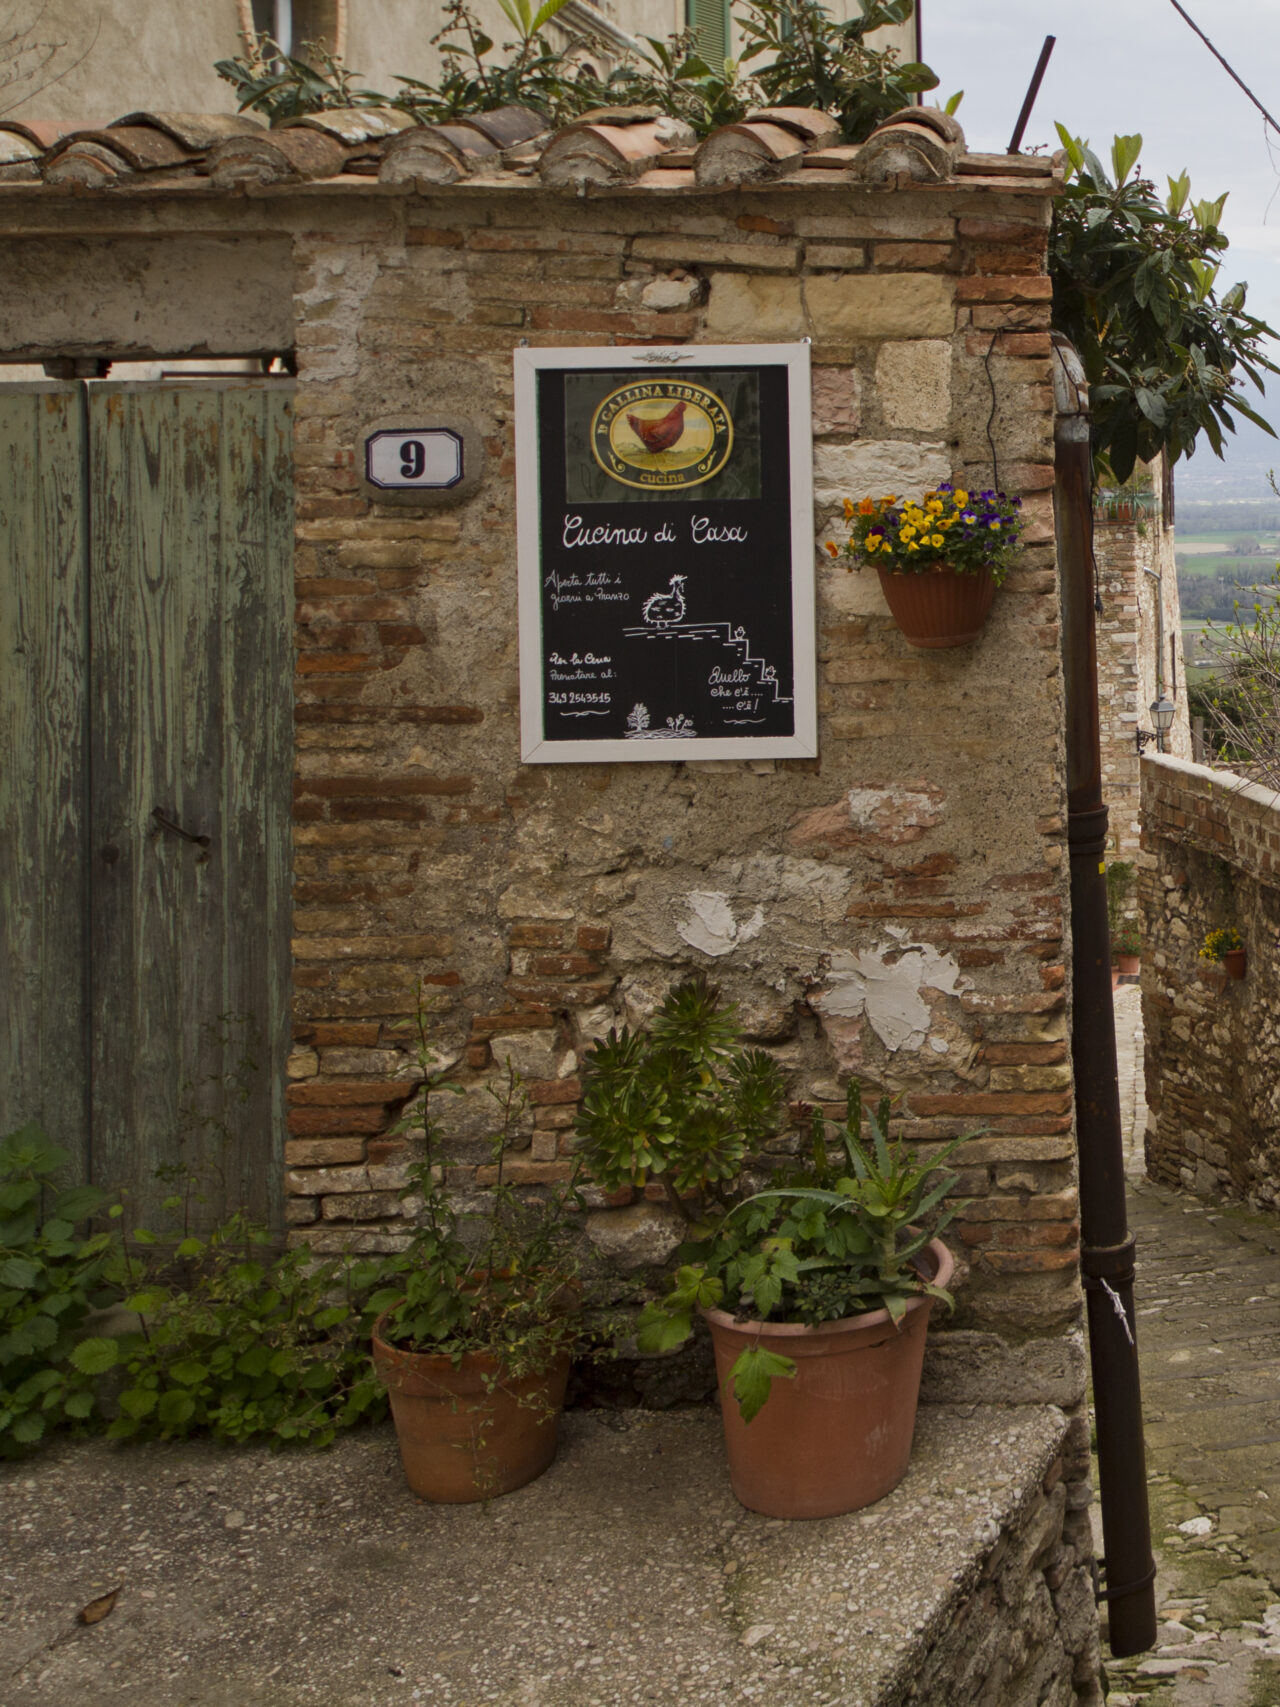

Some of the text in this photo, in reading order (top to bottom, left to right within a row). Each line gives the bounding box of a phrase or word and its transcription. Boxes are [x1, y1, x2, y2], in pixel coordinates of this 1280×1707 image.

[601, 385, 664, 421] GALLINA
[667, 385, 727, 434] LIBERATA
[400, 440, 425, 479] 9
[640, 472, 685, 484] cucina
[563, 514, 748, 548] Cucina di Casa
[584, 572, 611, 586] tutti
[614, 573, 622, 584] i
[550, 591, 582, 611] giorni
[594, 587, 630, 601] Pranzo
[584, 652, 611, 664] Cena
[708, 666, 751, 685] Quello
[710, 685, 732, 697] che
